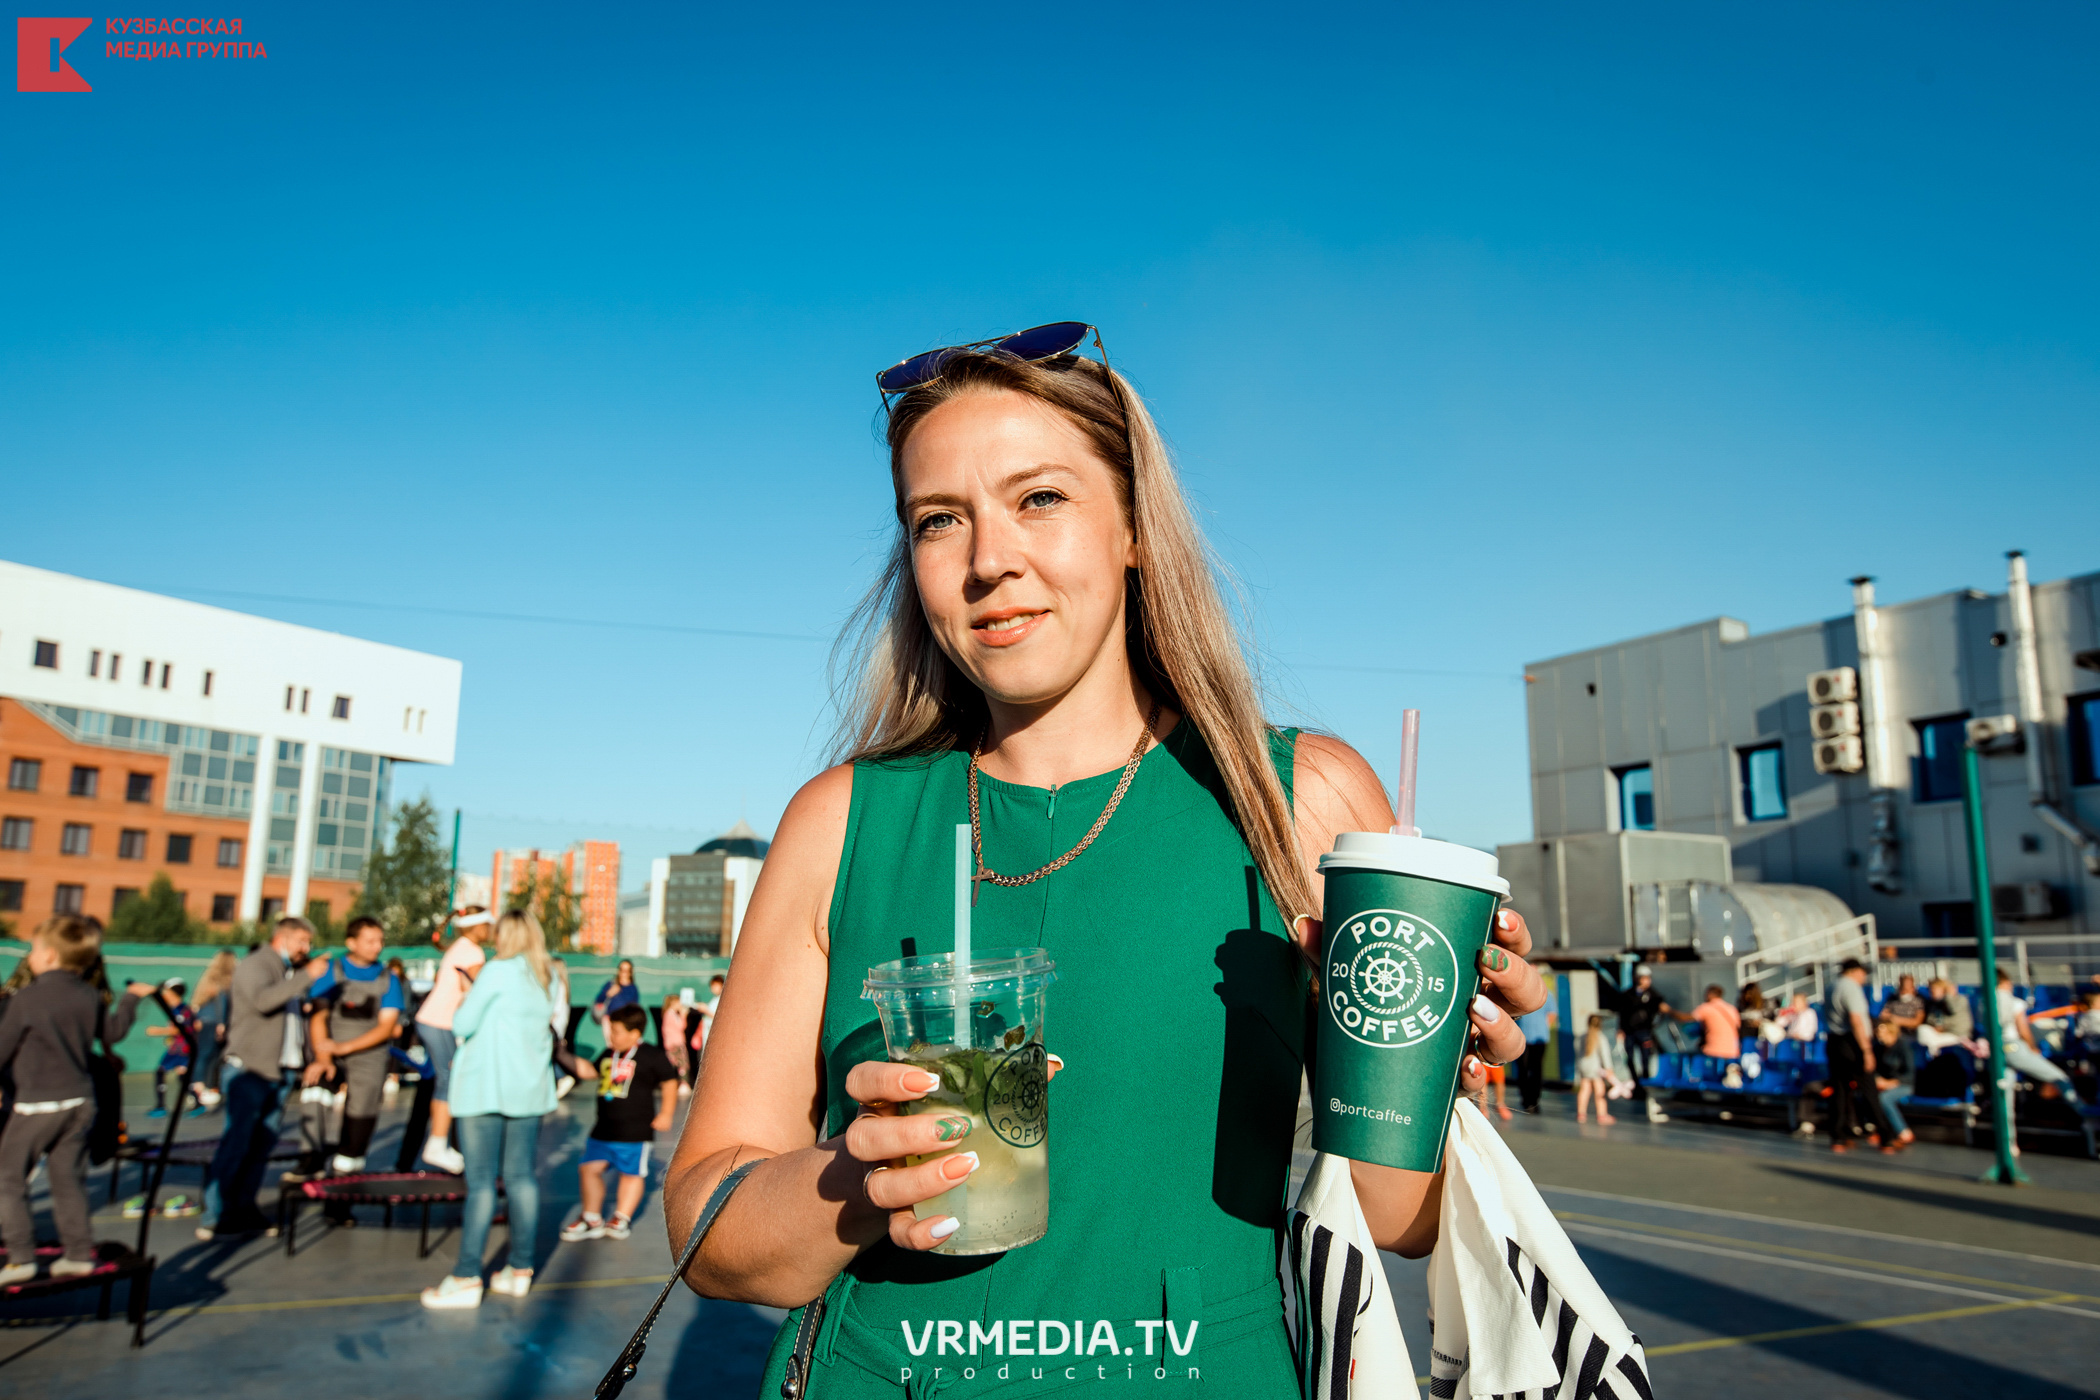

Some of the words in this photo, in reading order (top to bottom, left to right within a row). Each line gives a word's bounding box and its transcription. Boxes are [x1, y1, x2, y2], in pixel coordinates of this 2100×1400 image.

[1350, 916, 1435, 951] PORT
[1331, 962, 1349, 978] 20
[1427, 976, 1445, 993] 15
[1333, 990, 1440, 1042] COFFEE
[993, 1093, 1010, 1105] 20
[999, 1111, 1048, 1143] COFFE
